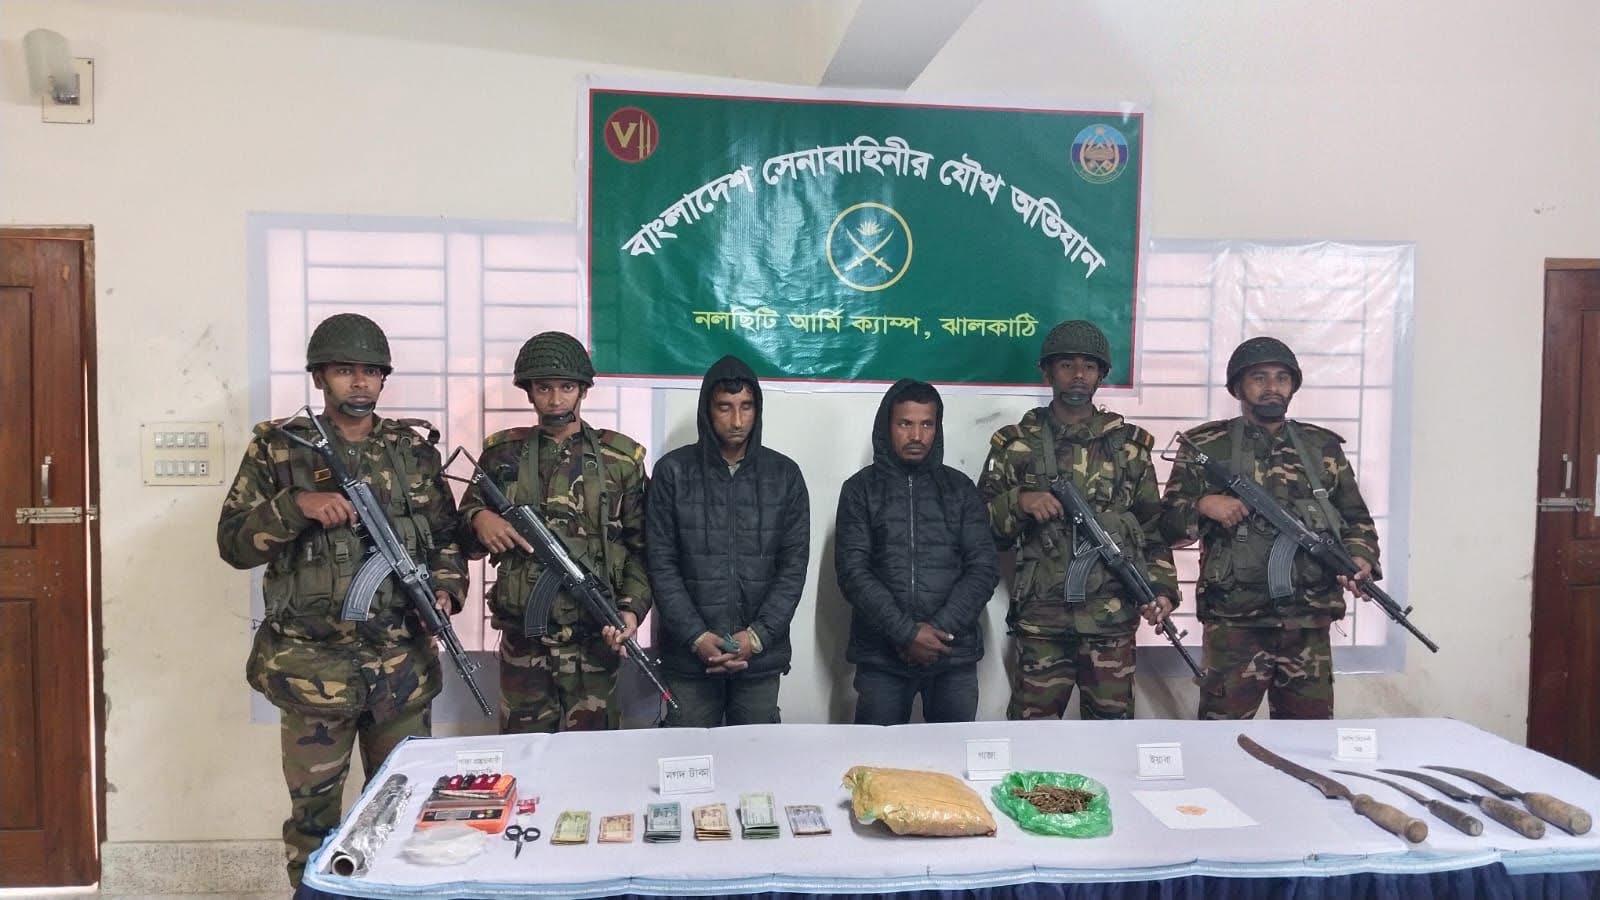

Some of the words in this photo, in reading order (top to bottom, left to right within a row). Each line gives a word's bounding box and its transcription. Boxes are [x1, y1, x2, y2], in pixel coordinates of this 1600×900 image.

[620, 163, 755, 256] বাংলাদেশ
[762, 135, 935, 186] সেনাবাহিনীর
[938, 152, 1006, 205] যৌথ
[1010, 184, 1106, 279] অভিযান
[692, 304, 780, 334] নলছিটি
[786, 307, 845, 334] আর্মি
[938, 312, 1040, 338] ঝালকাঠি
